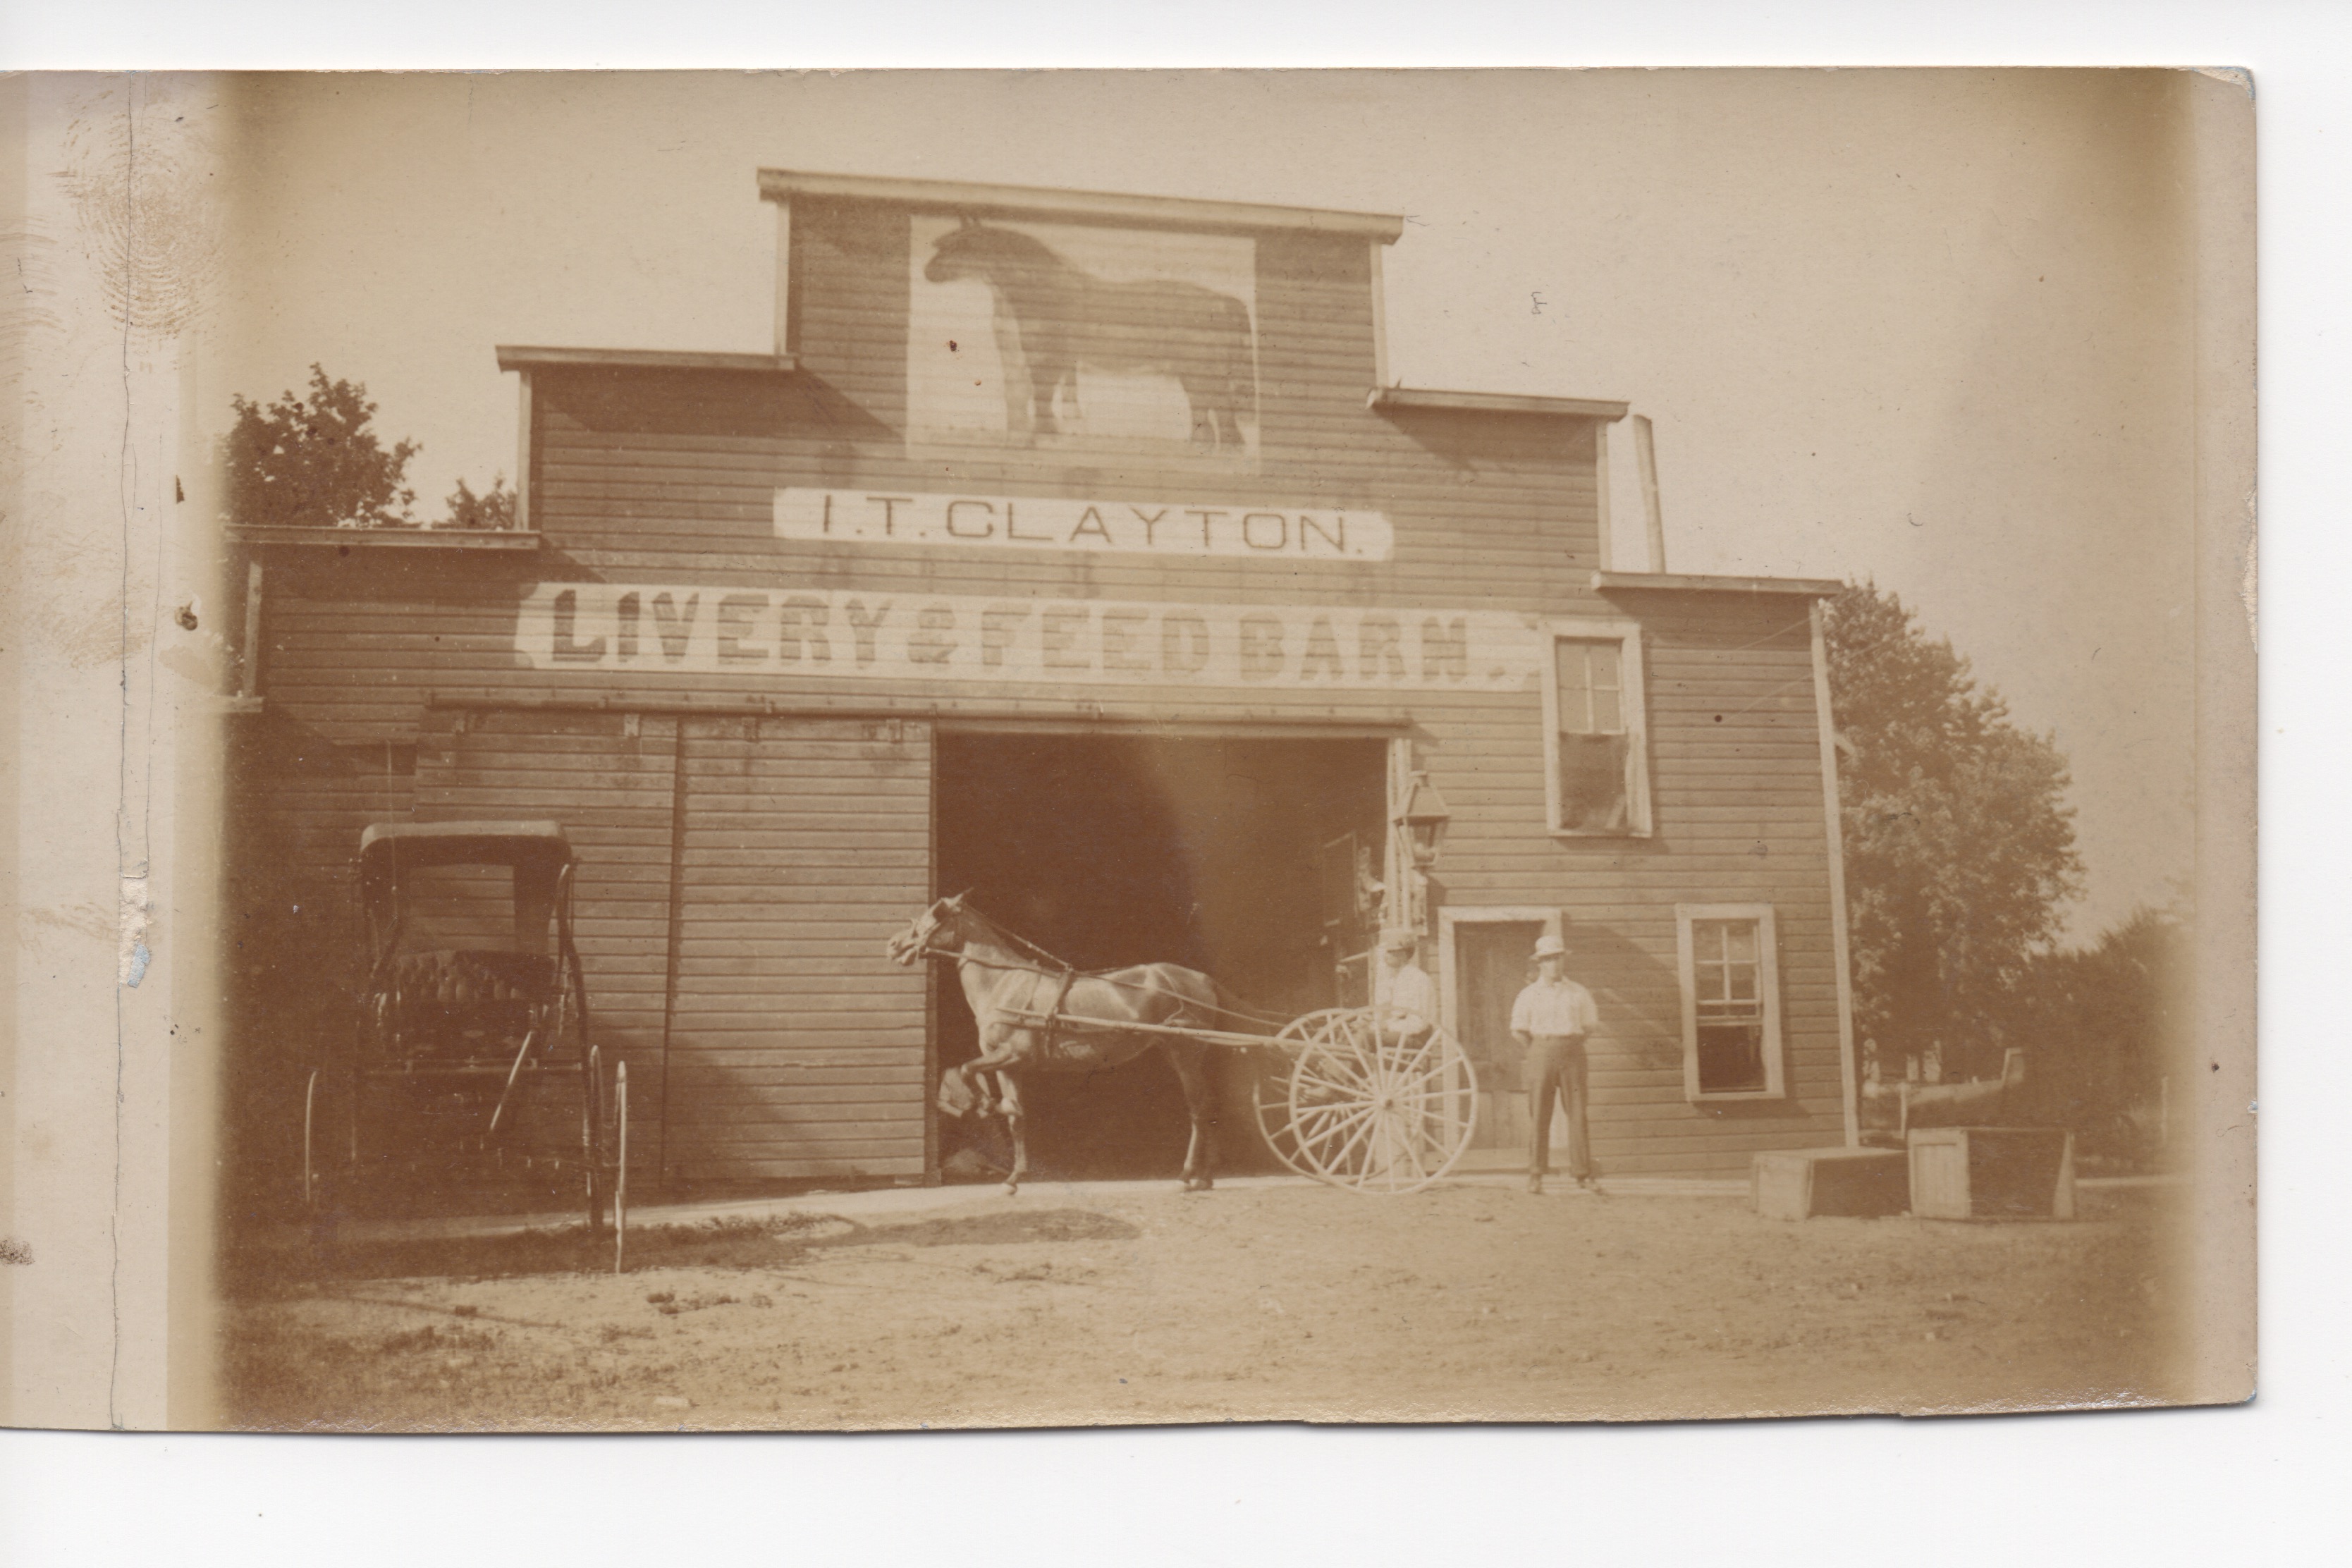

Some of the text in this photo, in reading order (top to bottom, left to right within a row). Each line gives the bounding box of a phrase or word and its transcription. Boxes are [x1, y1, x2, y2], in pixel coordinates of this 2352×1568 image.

[945, 498, 1363, 553] CLAYTON.
[552, 588, 891, 668] LIVERY
[907, 601, 960, 668] &
[981, 602, 1211, 674] FEED
